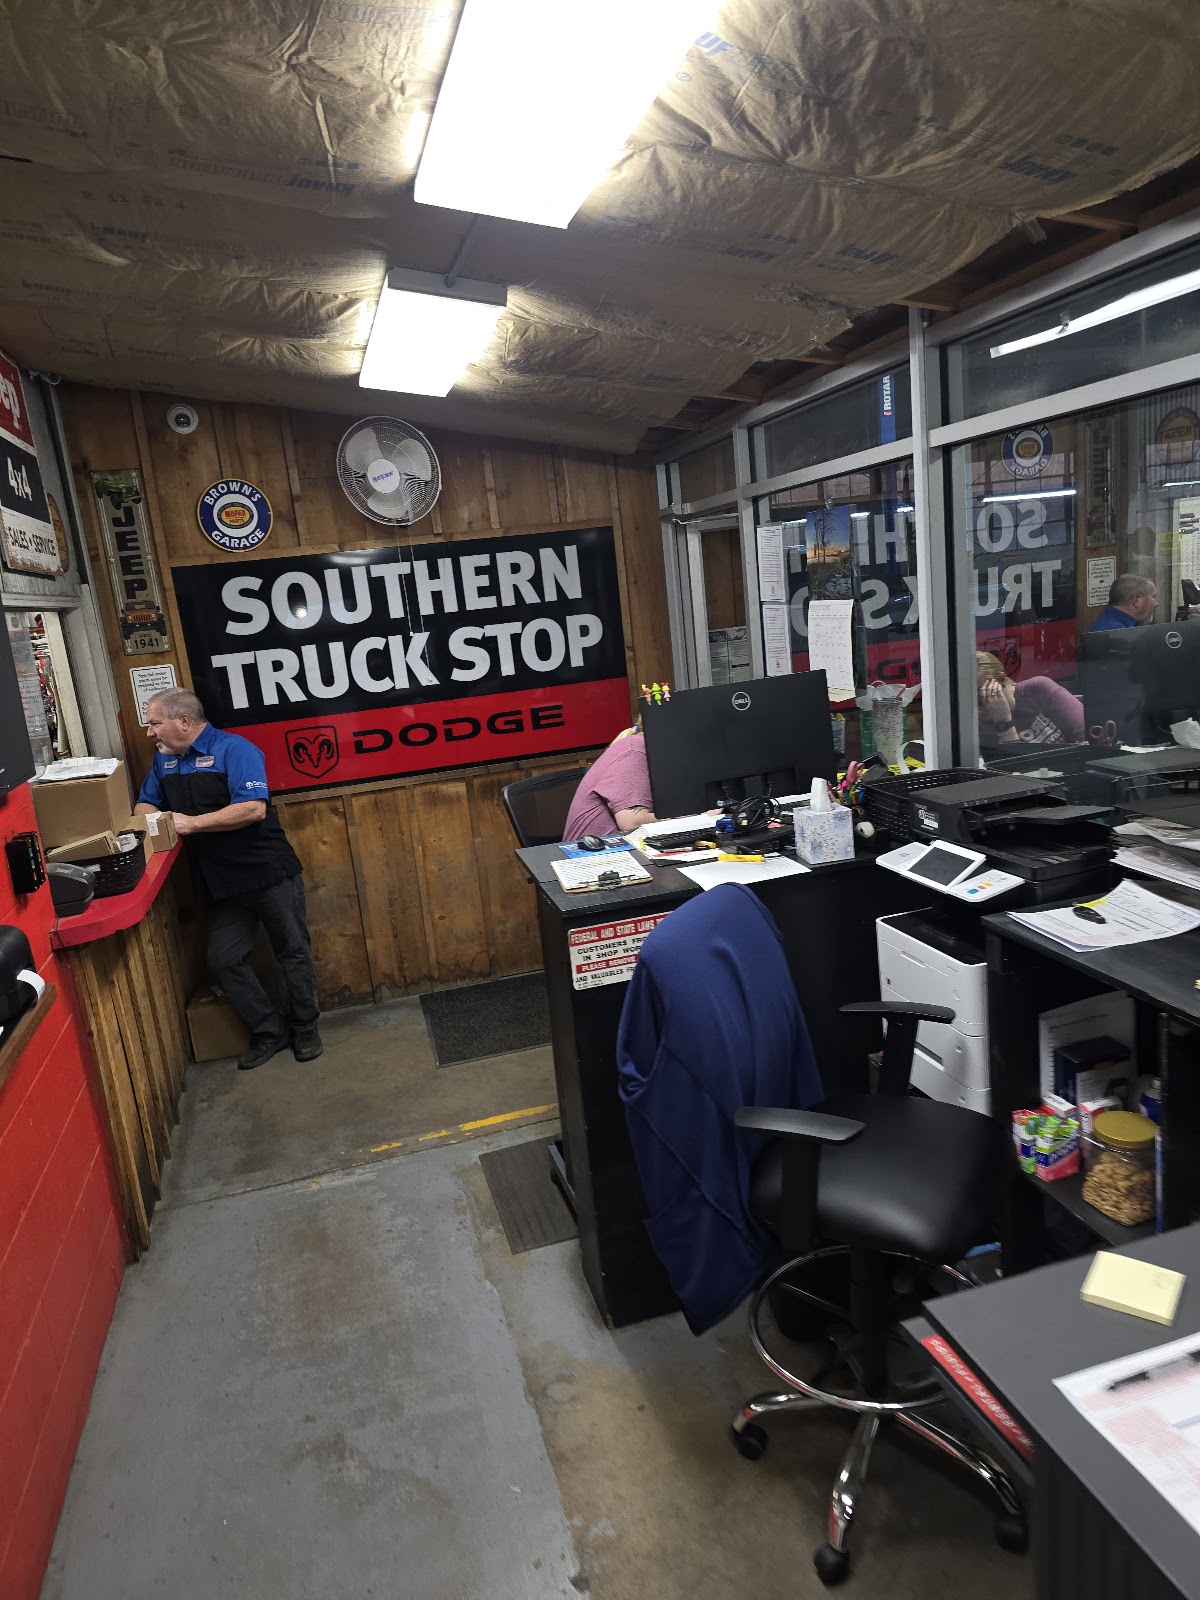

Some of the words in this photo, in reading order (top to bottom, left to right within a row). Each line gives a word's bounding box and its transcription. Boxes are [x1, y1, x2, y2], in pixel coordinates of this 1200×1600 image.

[0, 372, 21, 431] ep
[883, 374, 892, 411] ROTAR
[7, 456, 33, 502] 4x4
[203, 481, 262, 506] BROWN'S
[224, 510, 247, 518] MOPAR
[8, 526, 29, 551] SALES
[31, 533, 57, 557] SERVICE
[211, 528, 265, 548] GARAGE
[111, 505, 148, 600] JEEP
[221, 544, 583, 636] SOUTHERN
[133, 638, 160, 650] 1941
[211, 631, 440, 710] TRUCK
[447, 613, 604, 682] STOP
[734, 697, 750, 705] DELL
[353, 703, 566, 756] DODGE
[571, 931, 599, 945] FEDERAL
[601, 928, 615, 939] AND
[616, 924, 636, 936] STATE
[637, 920, 655, 932] LAWS
[577, 939, 627, 955] CUSTOMERS
[632, 936, 648, 944] FRO
[582, 954, 592, 962] IN
[596, 949, 619, 959] SHOP
[575, 975, 589, 984] AND
[590, 968, 624, 980] VALUABLES
[582, 961, 607, 972] PLEASE
[609, 955, 636, 967] REMOVE
